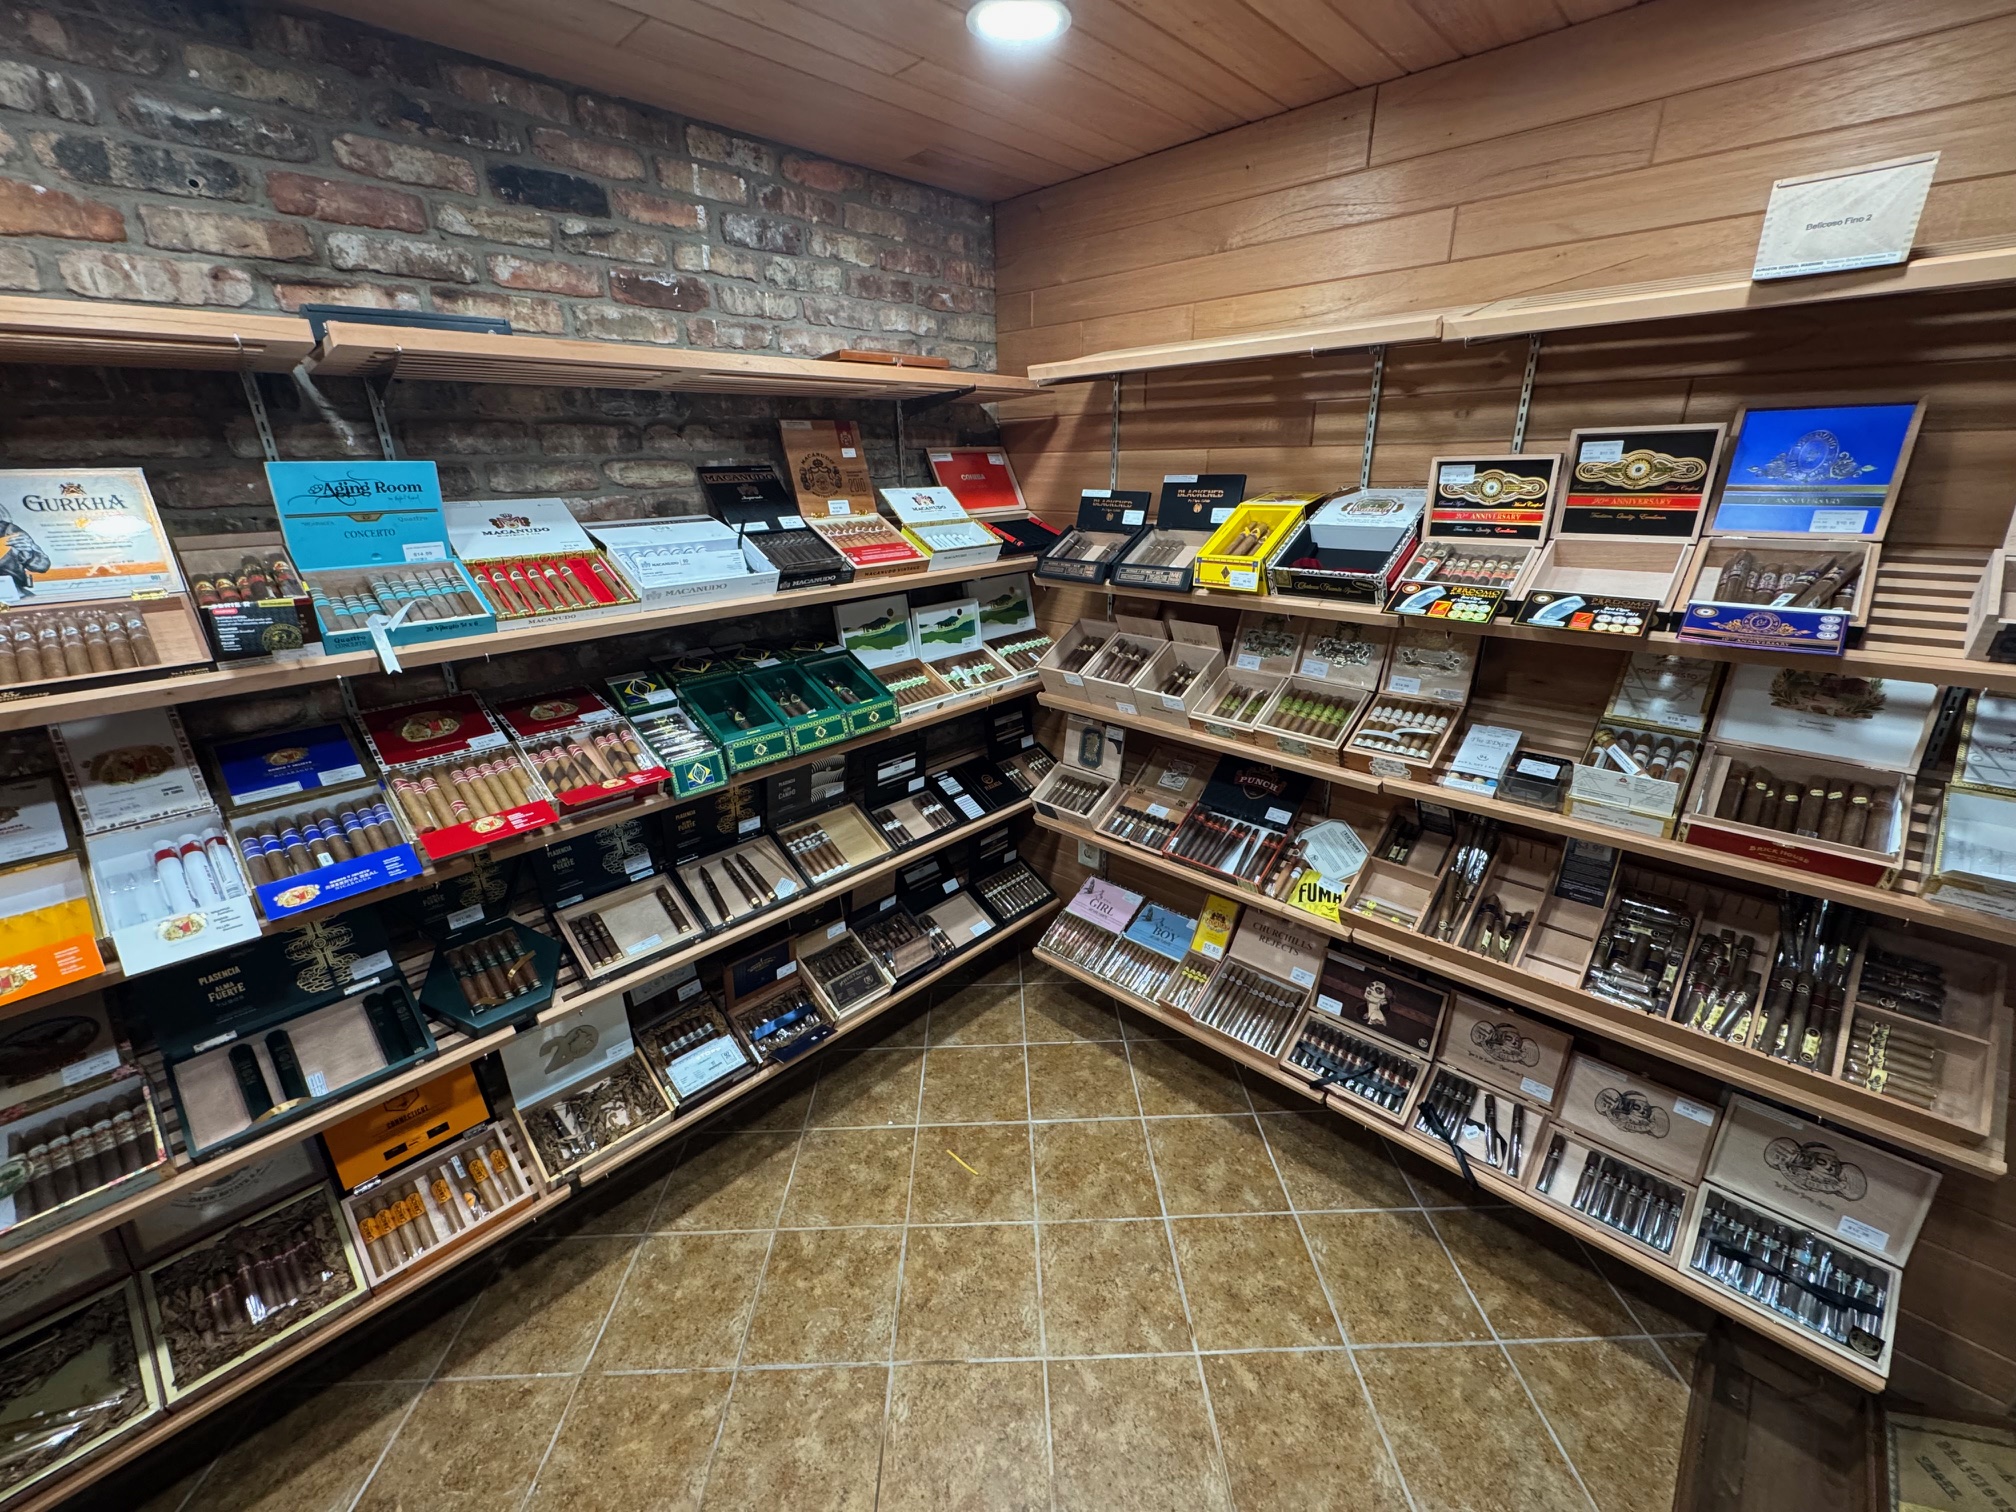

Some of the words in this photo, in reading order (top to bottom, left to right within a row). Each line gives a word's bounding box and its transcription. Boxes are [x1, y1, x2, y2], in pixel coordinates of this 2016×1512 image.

[1805, 218, 1843, 231] Belicoso
[1844, 216, 1864, 226] Fino
[1866, 213, 1873, 222] 2
[800, 452, 836, 466] MACANUDO
[704, 472, 776, 483] MACANUDO
[323, 481, 372, 497] Aging
[375, 481, 423, 494] Room
[1177, 489, 1225, 498] BLACKENED
[22, 494, 128, 512] GURKHA
[344, 528, 396, 539] CONCERTO
[481, 527, 550, 537] MACANUDO
[864, 568, 897, 577] MACANUDO
[897, 565, 921, 573] VINTAGE
[791, 575, 836, 587] MACANUDO
[665, 583, 728, 597] MACANUDO
[1450, 586, 1501, 597] PERDOMO
[1591, 597, 1651, 607] PERDOMO
[528, 614, 577, 625] MACANUDO
[333, 635, 366, 644] Quattro
[335, 641, 367, 649] CONCERTO
[1736, 638, 1790, 647] ANNIVERSARY
[1486, 739, 1512, 748] EDGE
[1238, 775, 1280, 793] PUNCH
[1749, 845, 1779, 855] BRICK
[1780, 850, 1810, 864] HOUSE
[1089, 898, 1114, 917] GIRL
[1152, 925, 1180, 943] BOY
[1252, 921, 1313, 951] CHURCHILLS
[1258, 934, 1300, 957] REJECTS
[198, 965, 242, 986] PLASENCIA
[207, 982, 246, 1003] FUERTE
[215, 981, 235, 992] ALMA
[386, 1104, 430, 1130] CONNECTICUT
